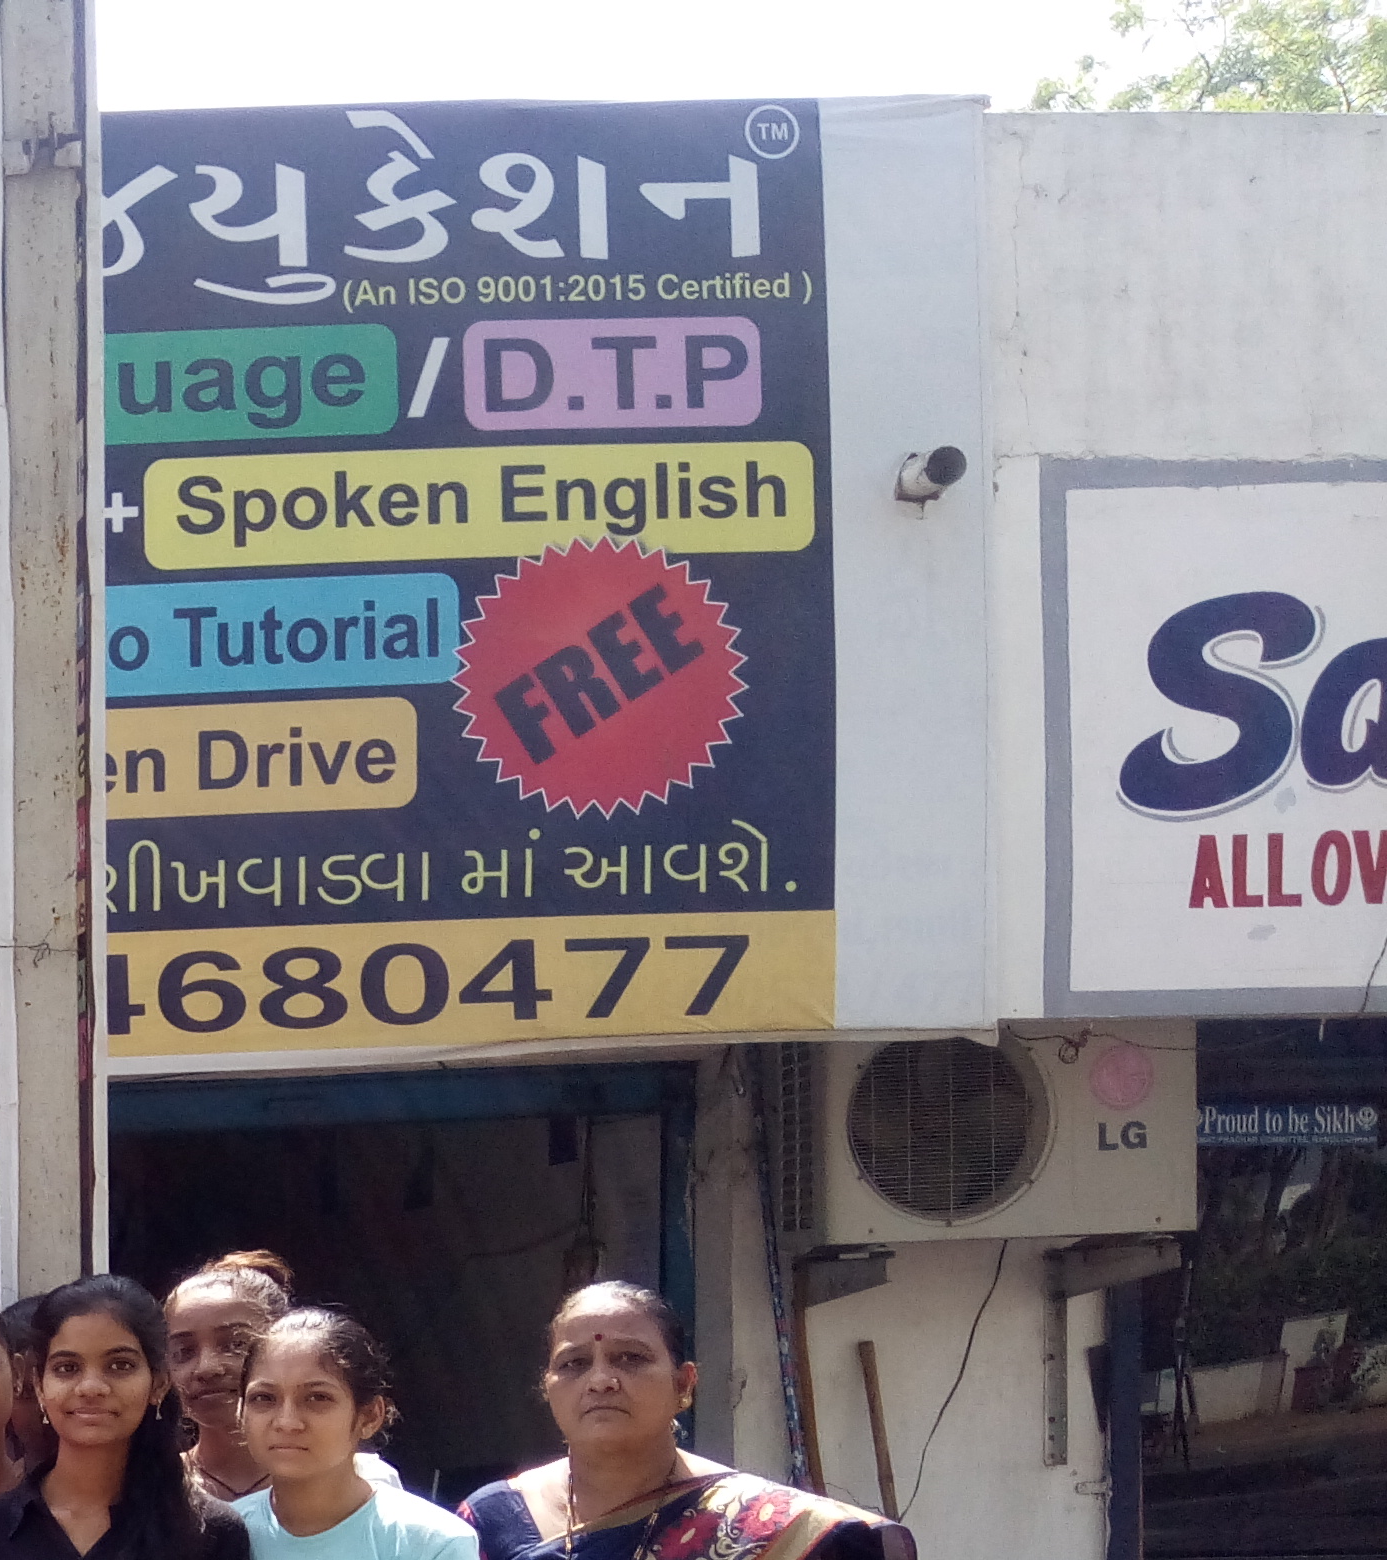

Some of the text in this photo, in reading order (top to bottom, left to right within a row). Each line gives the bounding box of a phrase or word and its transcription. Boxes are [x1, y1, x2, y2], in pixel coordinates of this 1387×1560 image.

[757, 121, 789, 142] TM
[343, 277, 399, 311] (An
[409, 278, 466, 307] ISO
[477, 274, 646, 304] 9001:2015
[656, 269, 791, 302] Certified
[483, 333, 749, 413] D.T.P
[176, 470, 470, 548] Spoken
[500, 460, 788, 537] English
[173, 597, 441, 671] Tutorial
[493, 583, 705, 766] FREE
[197, 726, 397, 791] Drive
[461, 829, 541, 899] માં
[1098, 1121, 1147, 1151] LG
[1204, 1105, 1356, 1134] Proud to be Sikh
